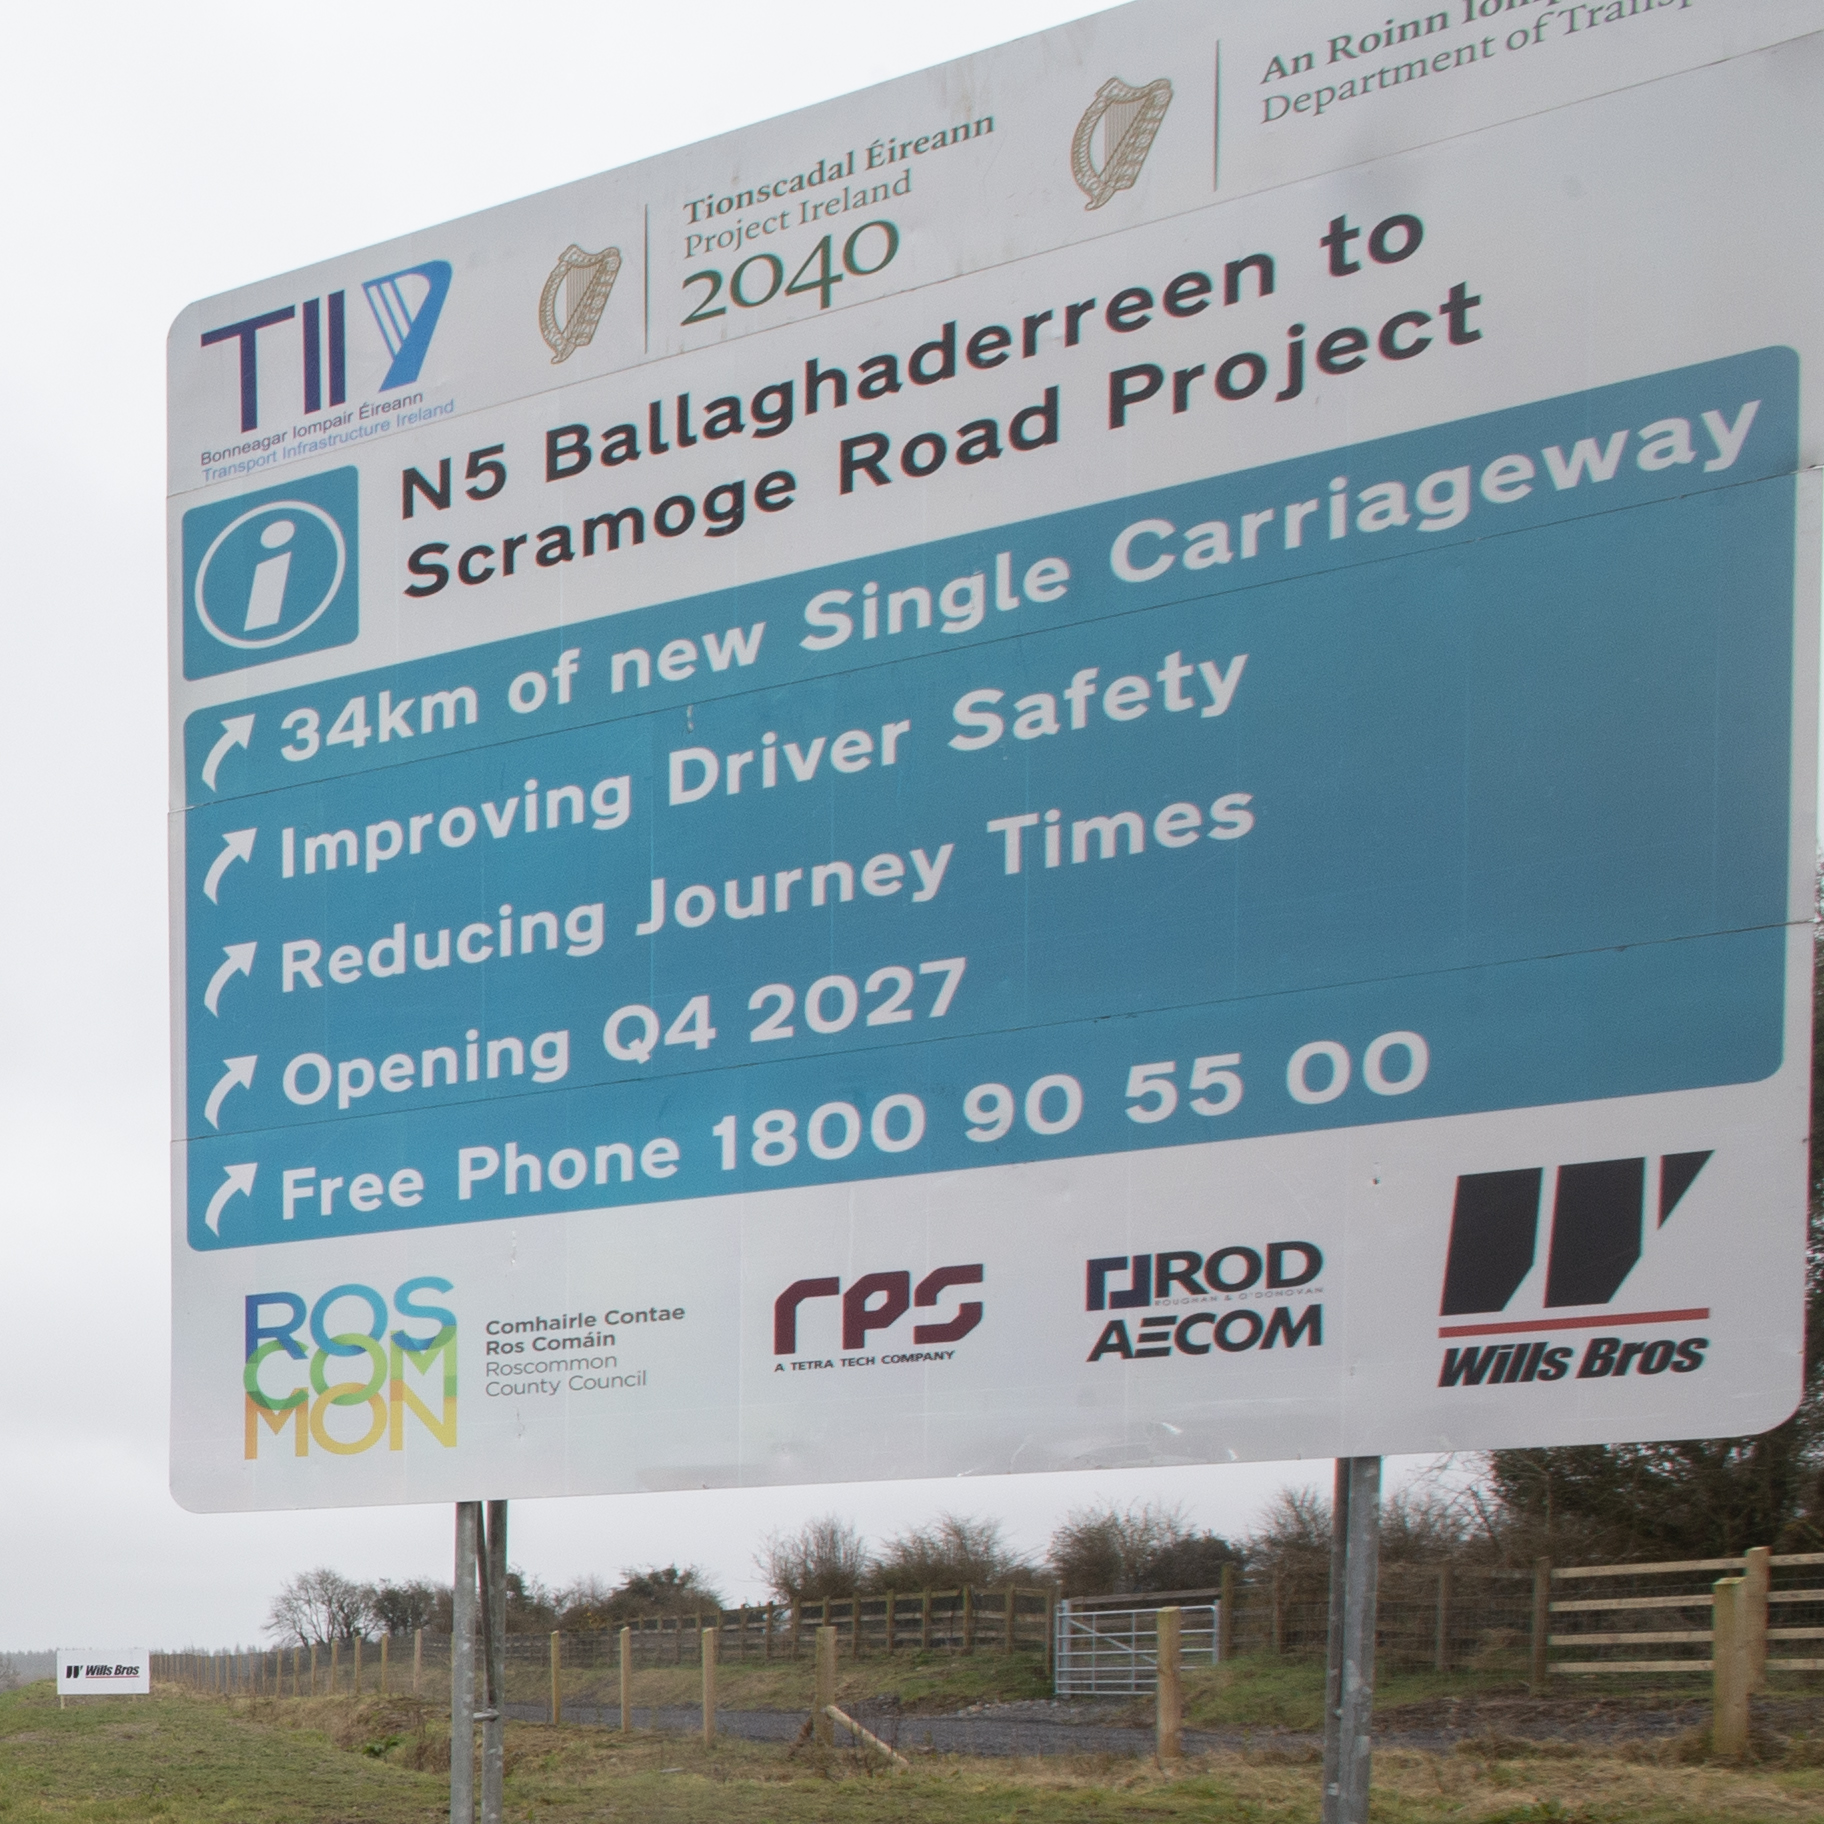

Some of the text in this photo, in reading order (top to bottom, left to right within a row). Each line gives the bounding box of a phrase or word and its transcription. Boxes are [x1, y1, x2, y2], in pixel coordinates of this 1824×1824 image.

[1259, 54, 1316, 85] An
[1326, 10, 1450, 65] Roinn
[1260, 35, 1497, 125] Department
[1506, 10, 1555, 52] of
[683, 114, 996, 226] Tionscadal Éireann
[683, 167, 913, 260] Project Ireland
[680, 218, 901, 327] 2040
[401, 213, 1425, 520] N5 Ballaghaderreen to
[201, 391, 424, 466] Bonneagar Iompair Éireann
[202, 398, 455, 482] Transport Infrastructure Ireland
[403, 281, 1483, 598] Scramoge Road Project
[279, 399, 1762, 762] 34km of new Single Carriageway
[281, 650, 1249, 879] Improving Driver Safety
[281, 792, 1255, 993] Reducing Journey Times
[282, 957, 967, 1110] Opening Q4 2027
[281, 1030, 1431, 1222] Free Phone 1800 90 55 00
[774, 1263, 983, 1355] rps
[1154, 1241, 1325, 1298] ROD
[245, 1276, 458, 1363] ROS
[486, 1307, 686, 1335] Comhairle Contae
[486, 1331, 616, 1356] Ros Comáin
[774, 1350, 956, 1372] A TETRA TECH COMPANY
[1086, 1304, 1325, 1362] AECOM
[1438, 1337, 1710, 1387] Wills Bros
[243, 1324, 458, 1411] COM
[486, 1355, 618, 1377] Roscommon
[486, 1370, 647, 1397] County Council
[244, 1379, 458, 1460] MON
[85, 1664, 113, 1676] Wills
[114, 1664, 140, 1675] Bros
